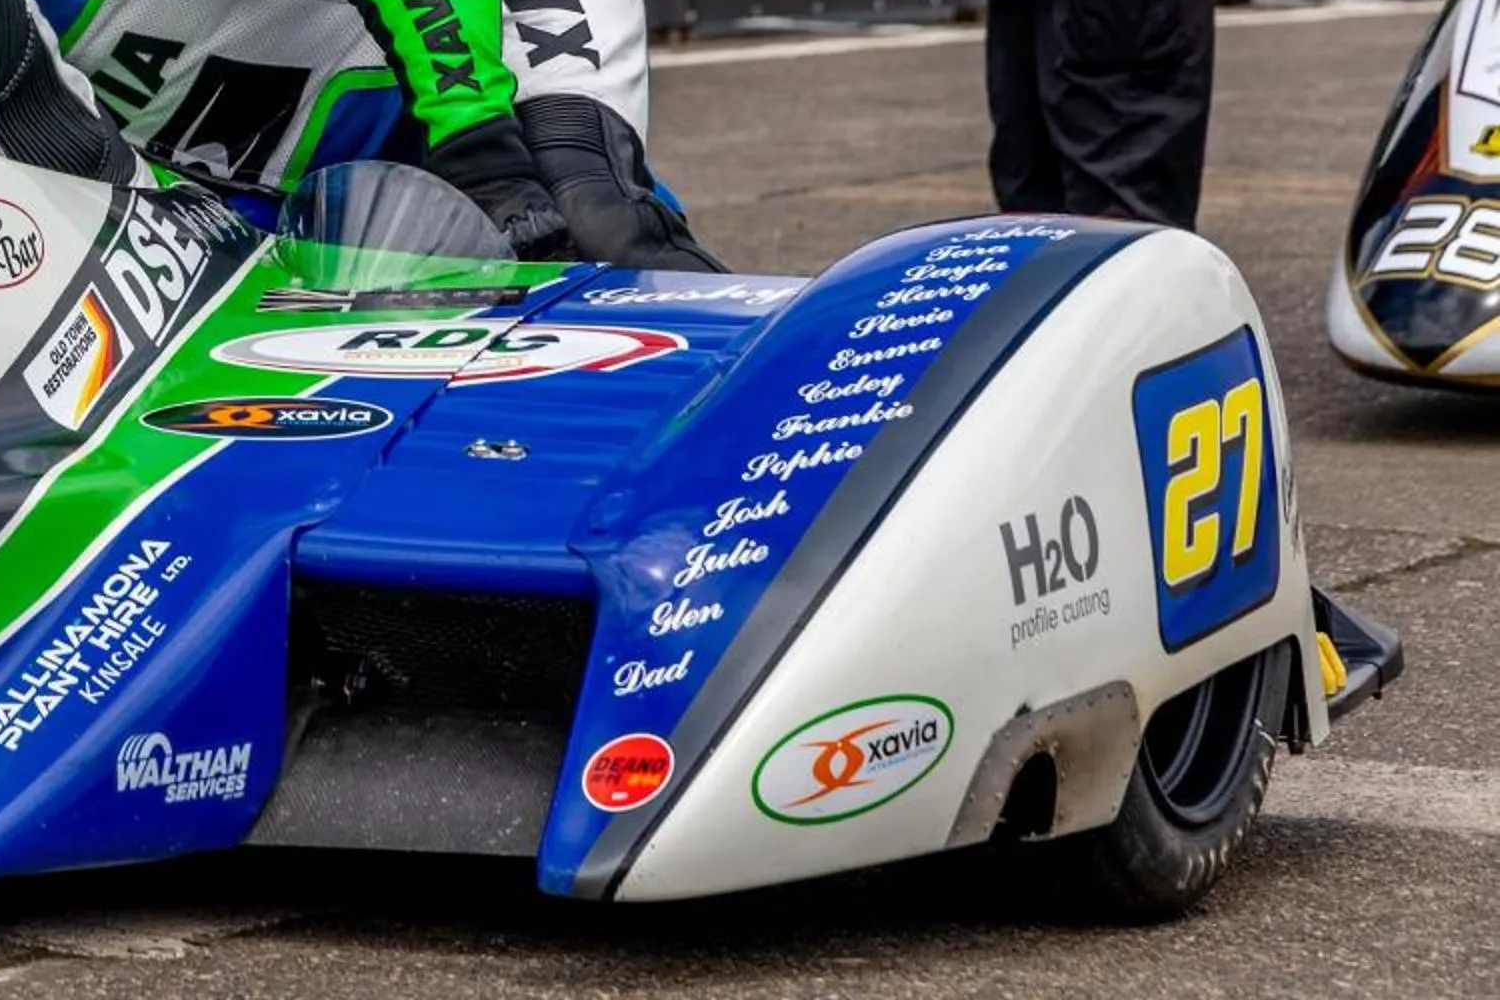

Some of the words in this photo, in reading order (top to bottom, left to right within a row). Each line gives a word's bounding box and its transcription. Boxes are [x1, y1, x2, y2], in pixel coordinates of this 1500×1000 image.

[901, 257, 1010, 284] Layla
[925, 244, 1011, 262] Tara
[876, 280, 991, 309] Harry
[848, 307, 954, 339] Stevie
[828, 336, 943, 372] Emma
[797, 373, 905, 405] Codey
[277, 408, 372, 421] xavia
[771, 400, 914, 441] Frankie
[741, 442, 863, 482] Sophie
[1162, 376, 1264, 592] 27
[703, 489, 791, 538] Josh
[673, 537, 769, 588] Julie
[998, 494, 1100, 607] H2O
[87, 581, 160, 651] HIRE
[649, 599, 724, 638] Glen
[1010, 603, 1059, 650] profile
[1061, 588, 1111, 625] cutting
[77, 615, 168, 705] KINSALE
[613, 650, 694, 697] Dad
[868, 717, 938, 764] xavia
[116, 742, 253, 793] WALTHAM
[164, 772, 247, 804] SERVICES
